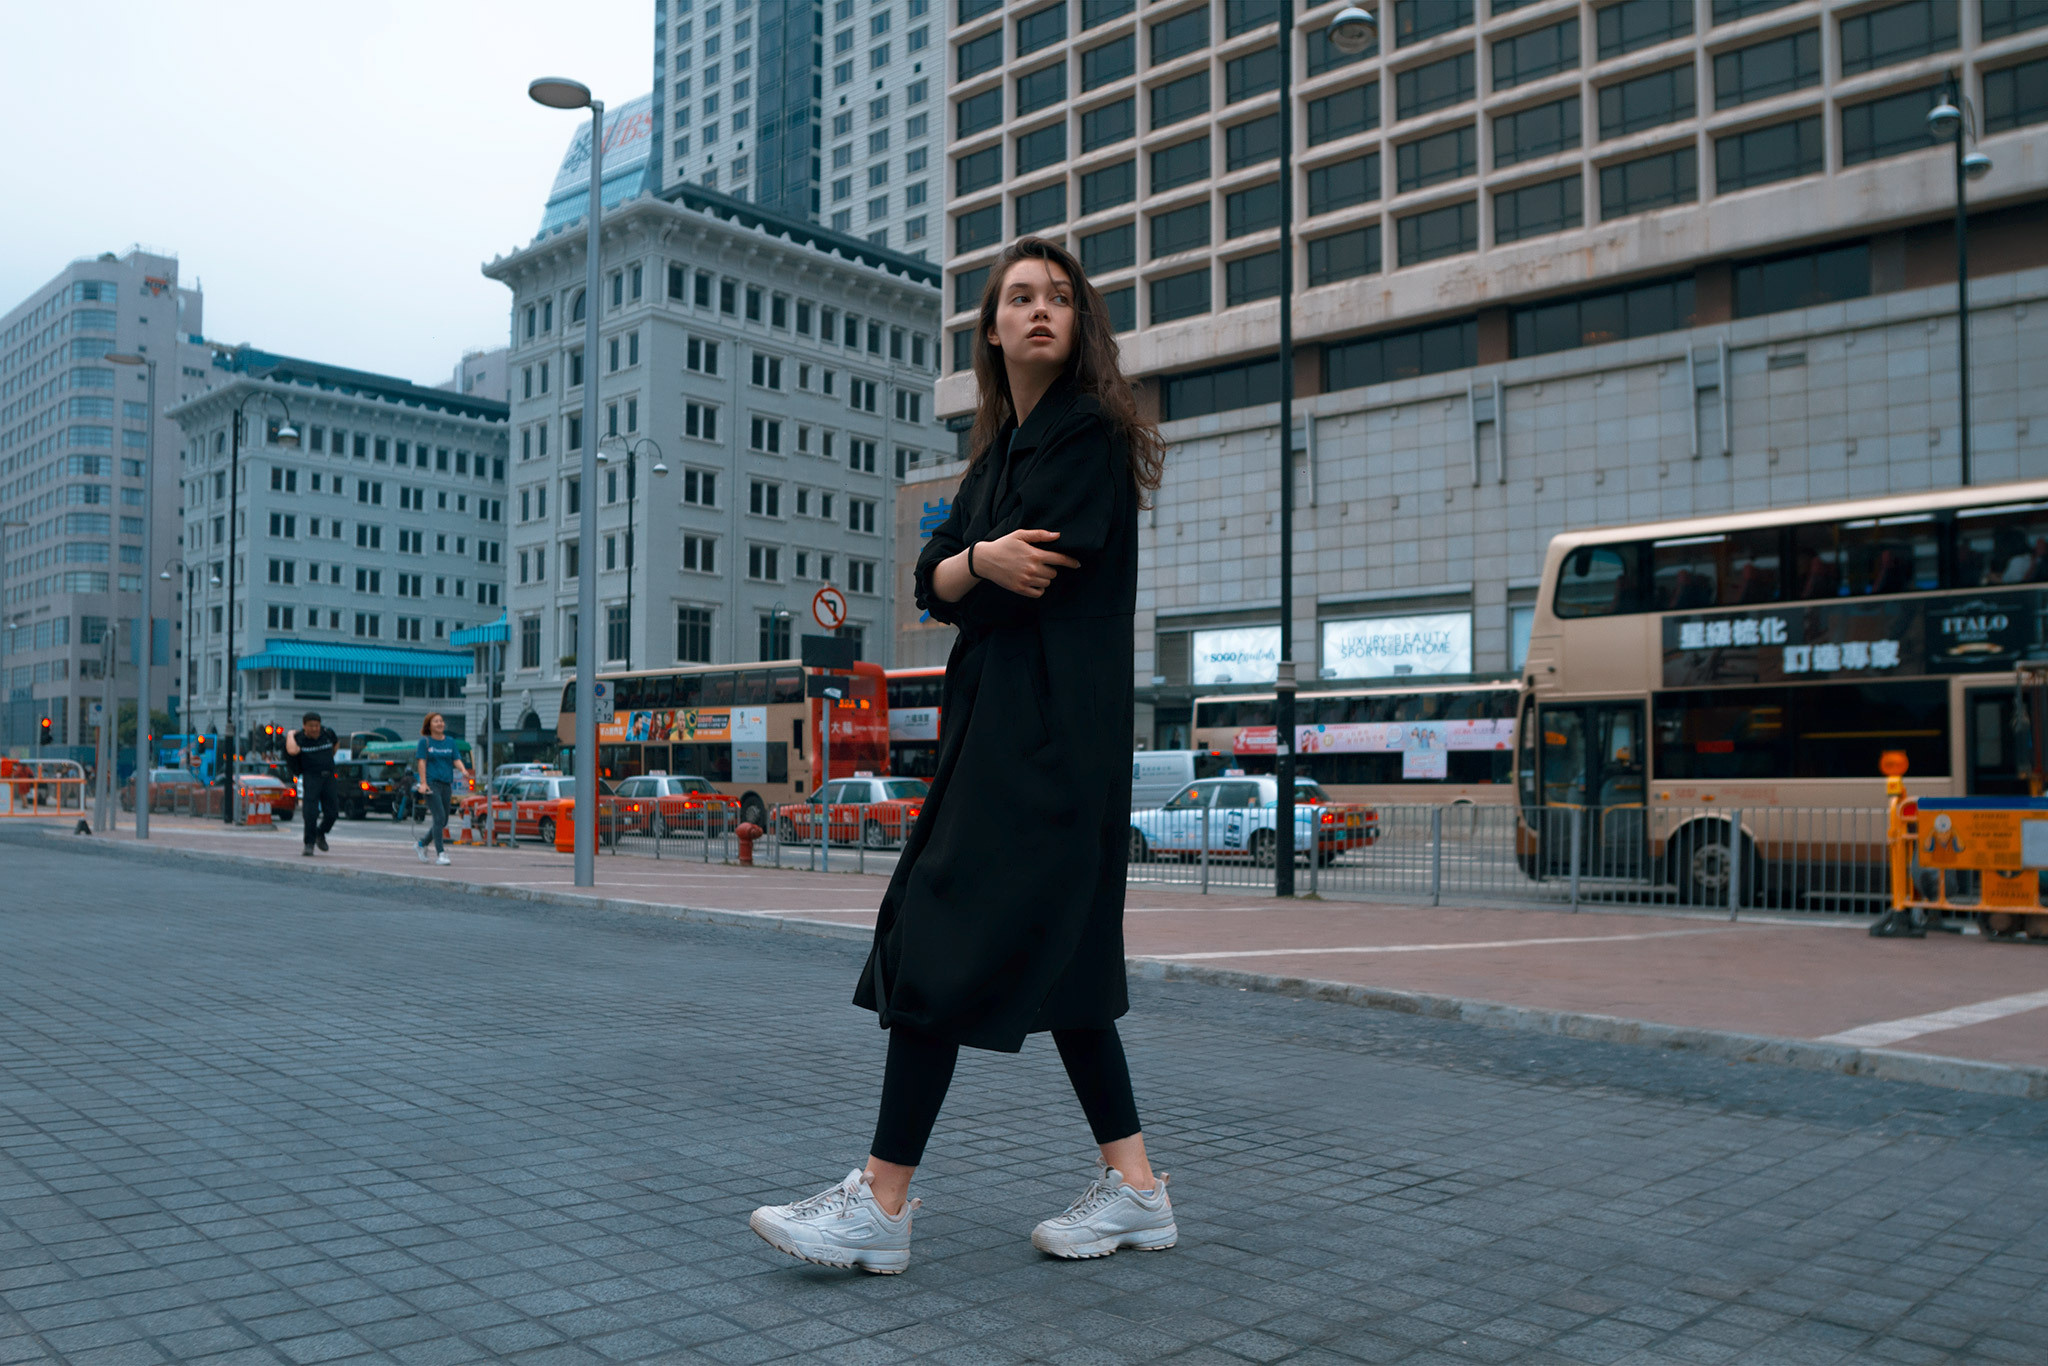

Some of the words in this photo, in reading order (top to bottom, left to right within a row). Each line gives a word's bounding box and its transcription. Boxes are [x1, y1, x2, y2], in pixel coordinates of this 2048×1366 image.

[600, 110, 652, 154] UBS
[1680, 616, 1788, 650] 星級梳化
[1942, 614, 2009, 635] ITALO
[1341, 635, 1387, 648] LUXURY
[1395, 631, 1451, 645] BEAUTY
[1341, 645, 1387, 659] SPORTS
[1783, 639, 1900, 674] 訂造專家
